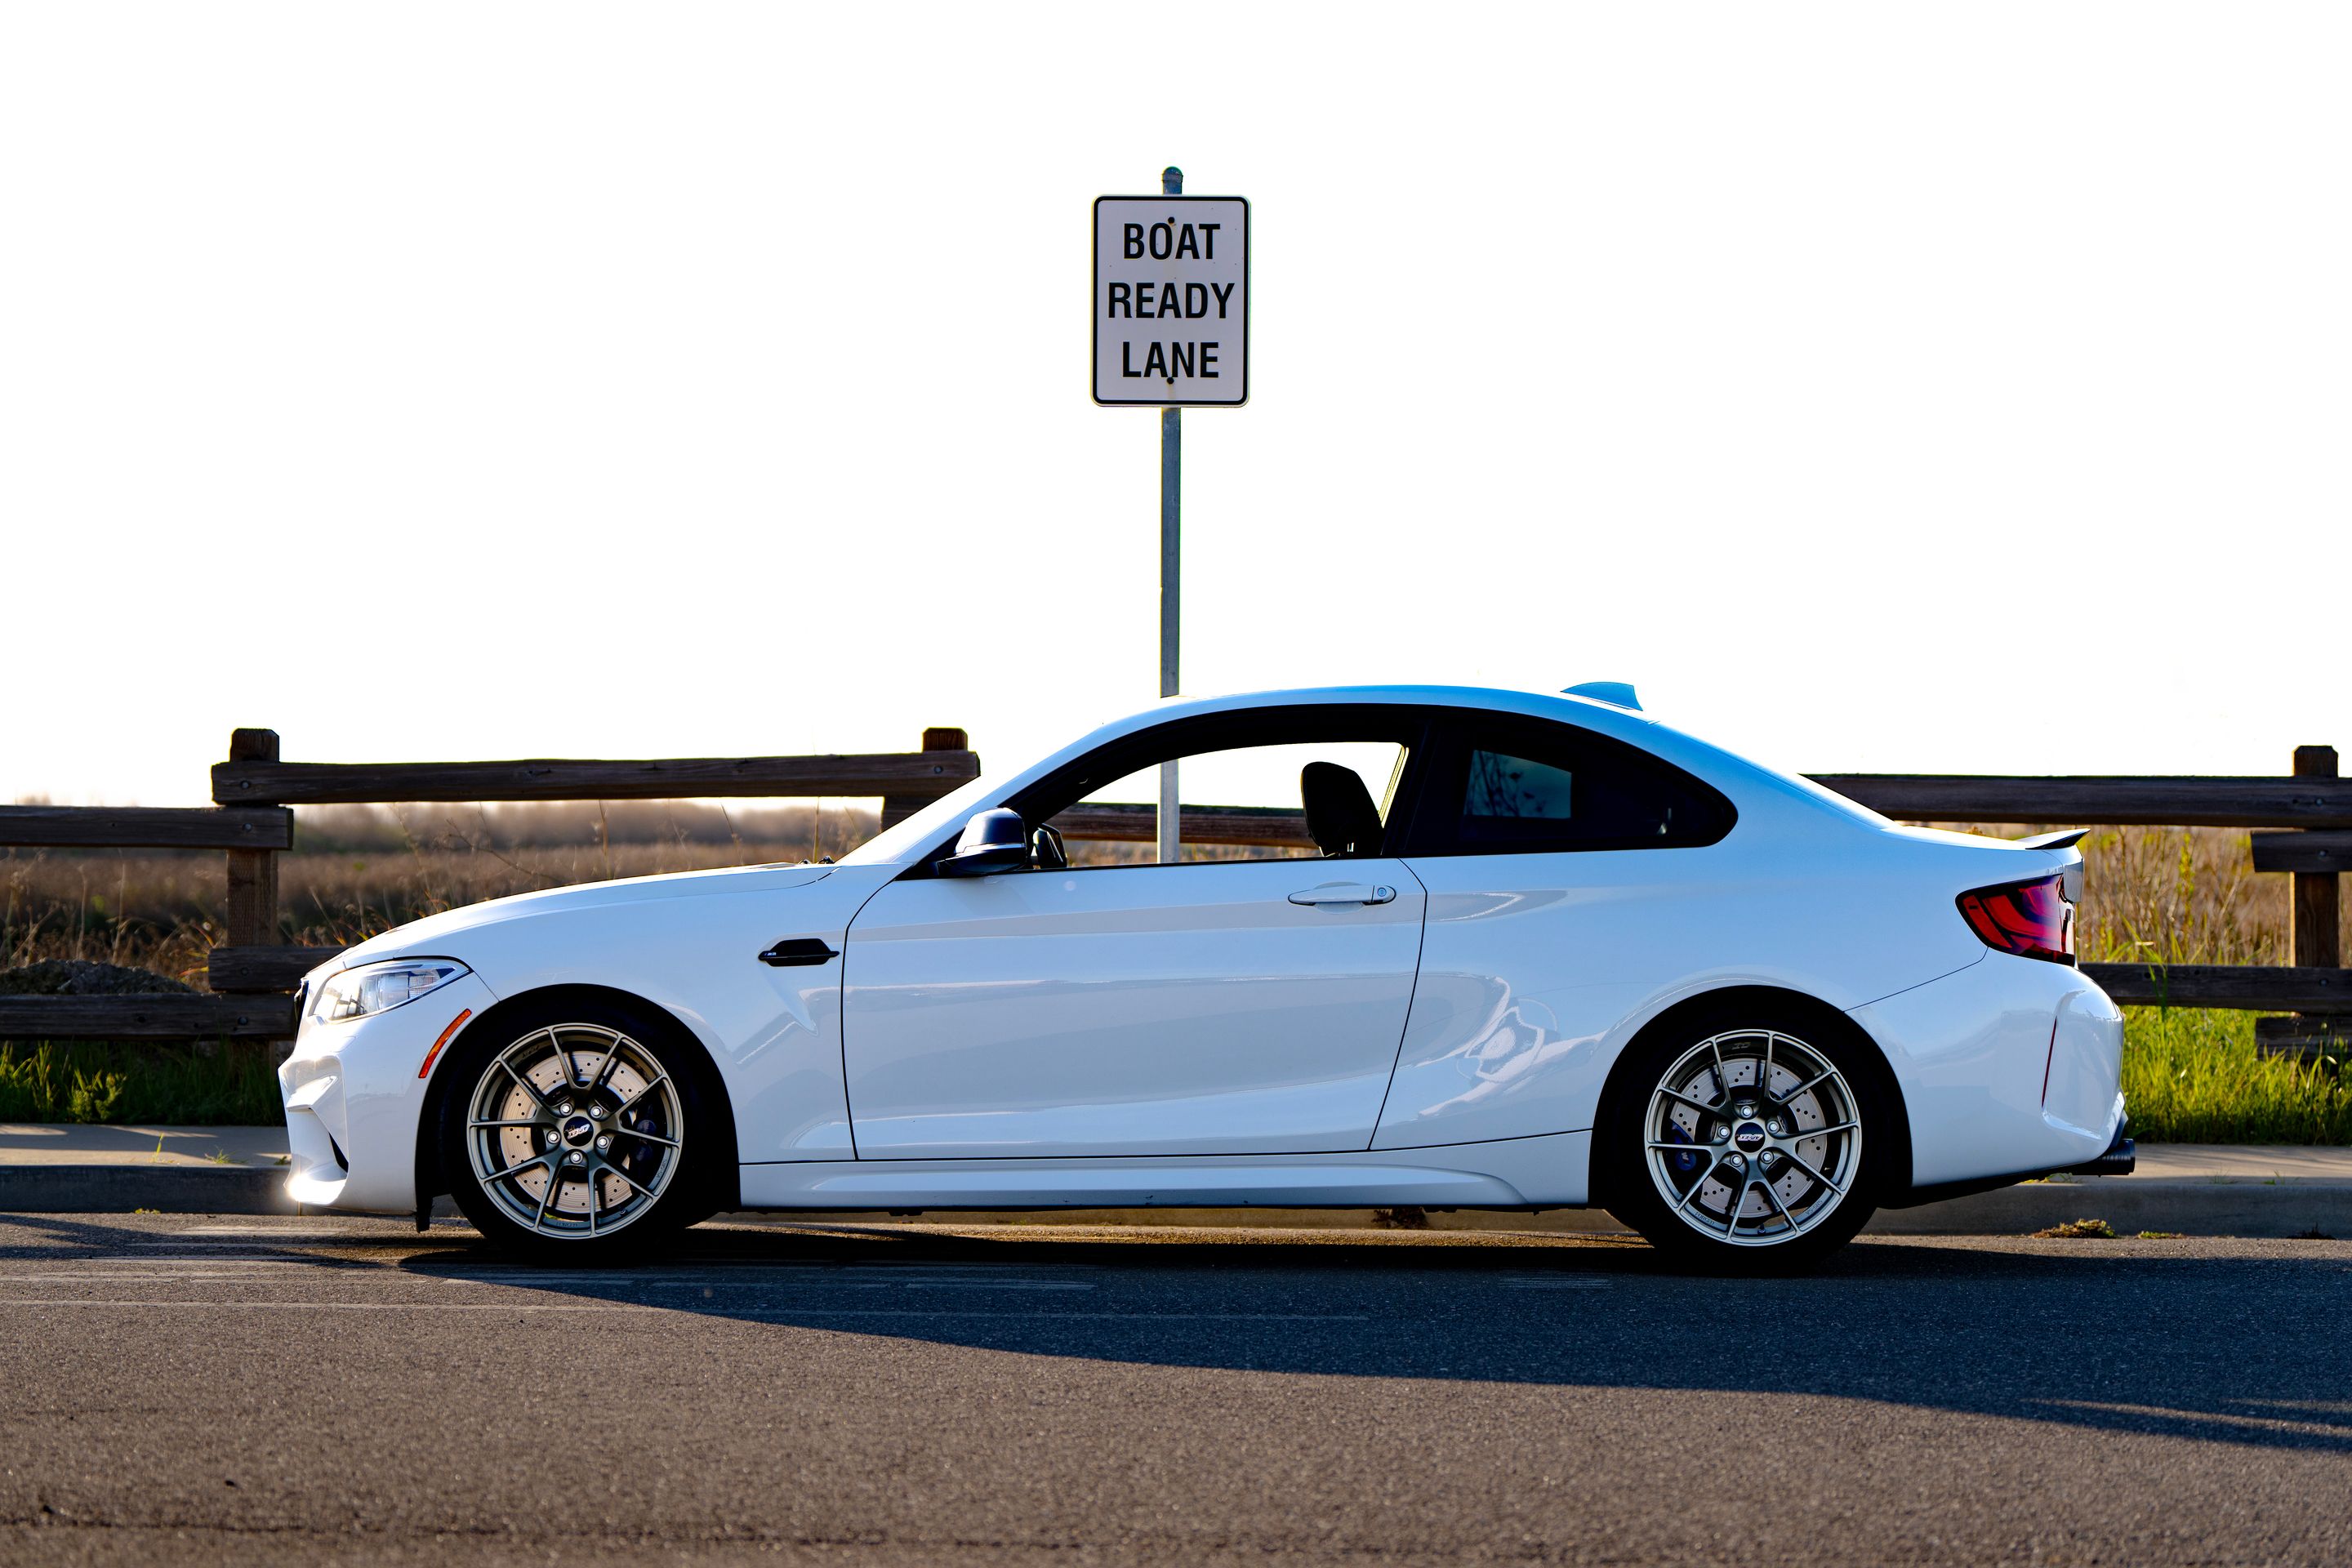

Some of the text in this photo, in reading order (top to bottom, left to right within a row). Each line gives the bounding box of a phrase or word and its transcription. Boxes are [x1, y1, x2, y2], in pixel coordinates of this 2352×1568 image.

[1123, 222, 1221, 261] BOAT
[1107, 282, 1236, 319] READY
[1122, 341, 1219, 379] LANE
